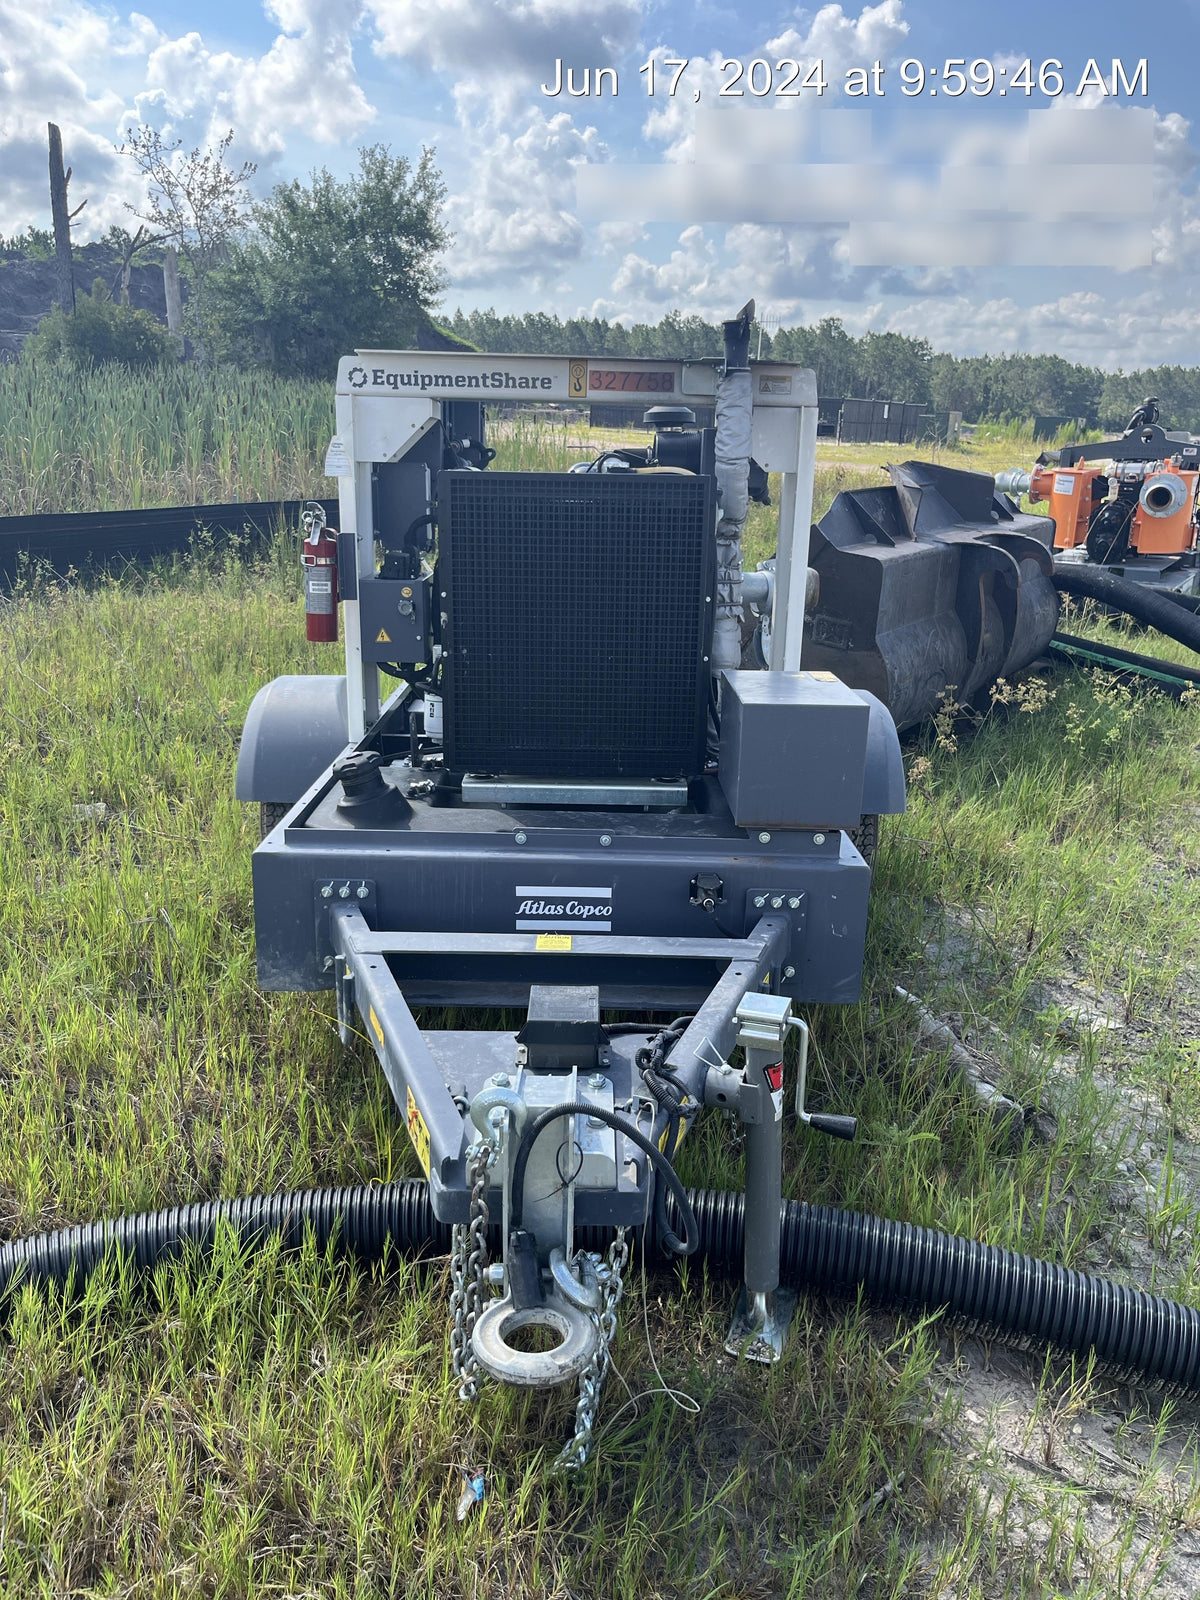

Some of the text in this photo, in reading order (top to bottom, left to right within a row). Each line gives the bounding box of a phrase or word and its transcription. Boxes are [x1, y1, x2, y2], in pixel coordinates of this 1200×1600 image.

[371, 369, 553, 391] EquipmentShare
[591, 370, 673, 391] 327758
[515, 900, 613, 918] Atlas Copco
